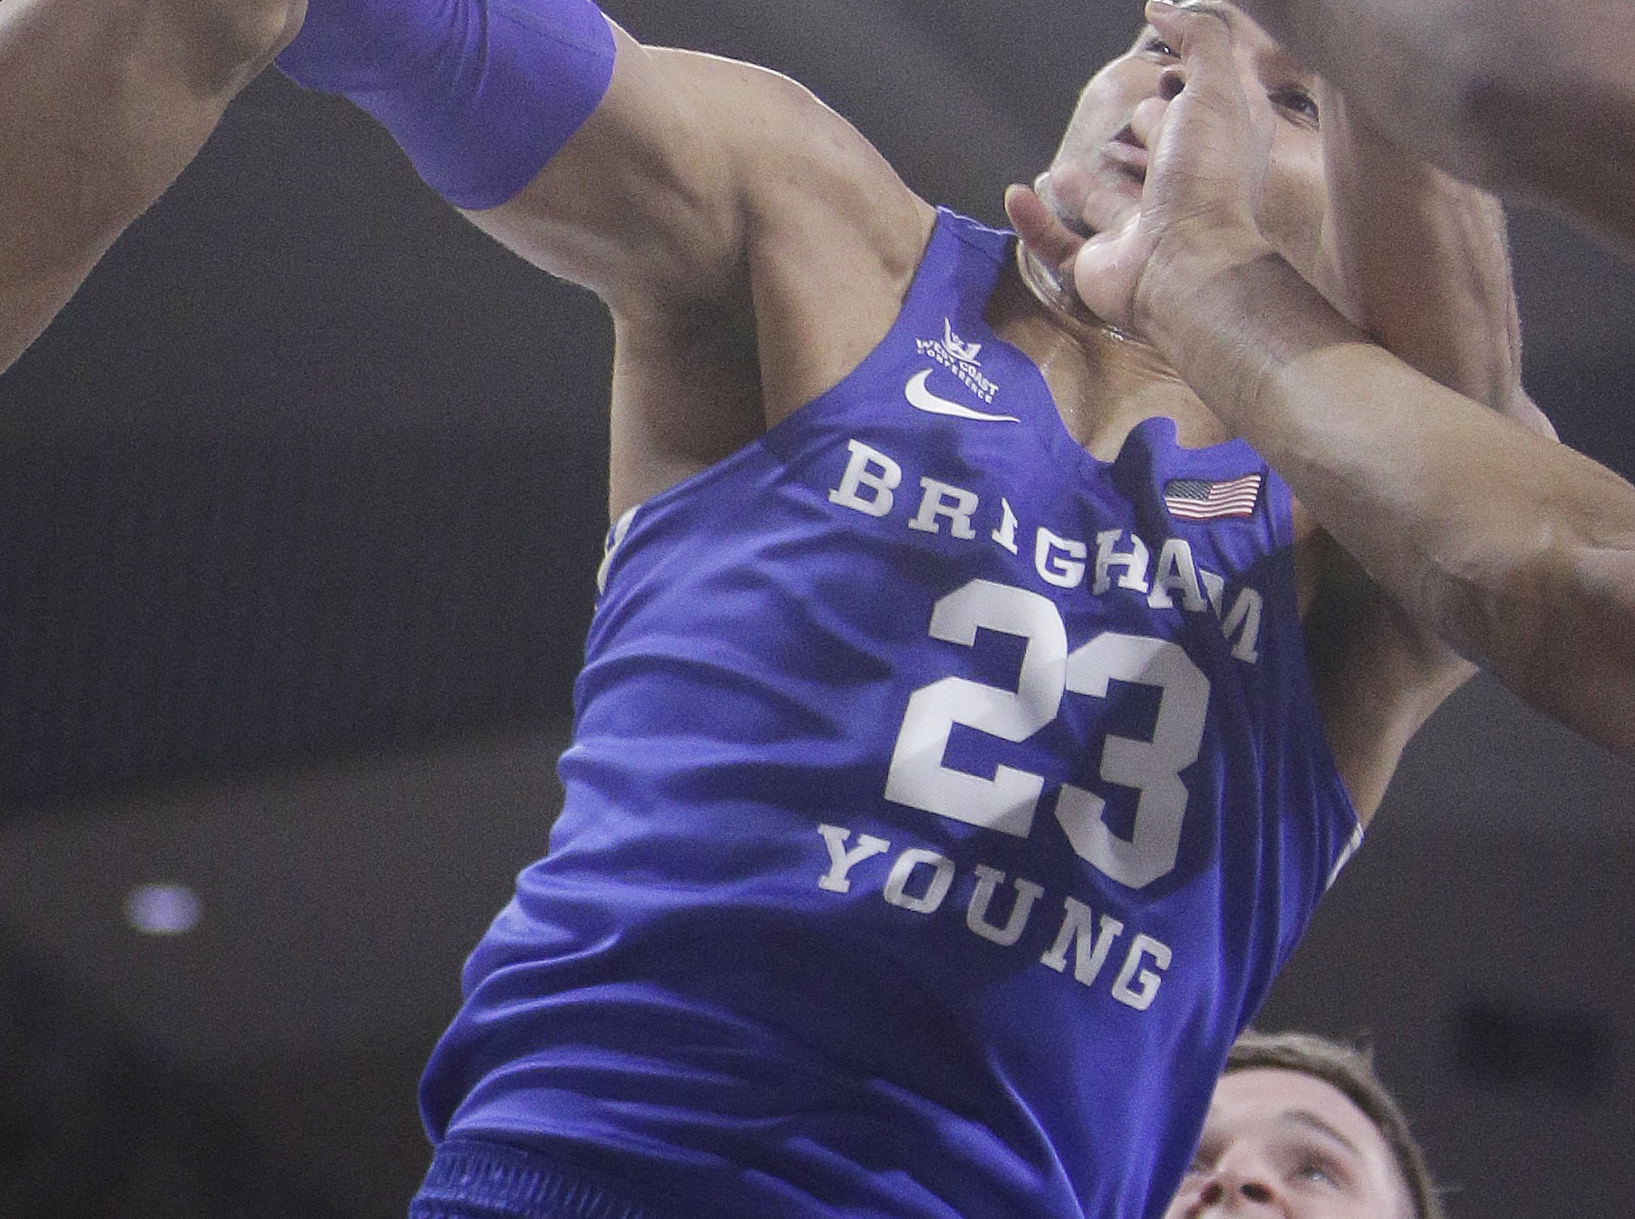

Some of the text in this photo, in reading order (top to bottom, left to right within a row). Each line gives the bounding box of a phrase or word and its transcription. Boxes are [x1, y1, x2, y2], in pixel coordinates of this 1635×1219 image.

[959, 361, 999, 396] COAST
[828, 439, 1262, 664] BRIGHAM
[884, 578, 1210, 891] 23
[817, 824, 1172, 1012] YOUNG
